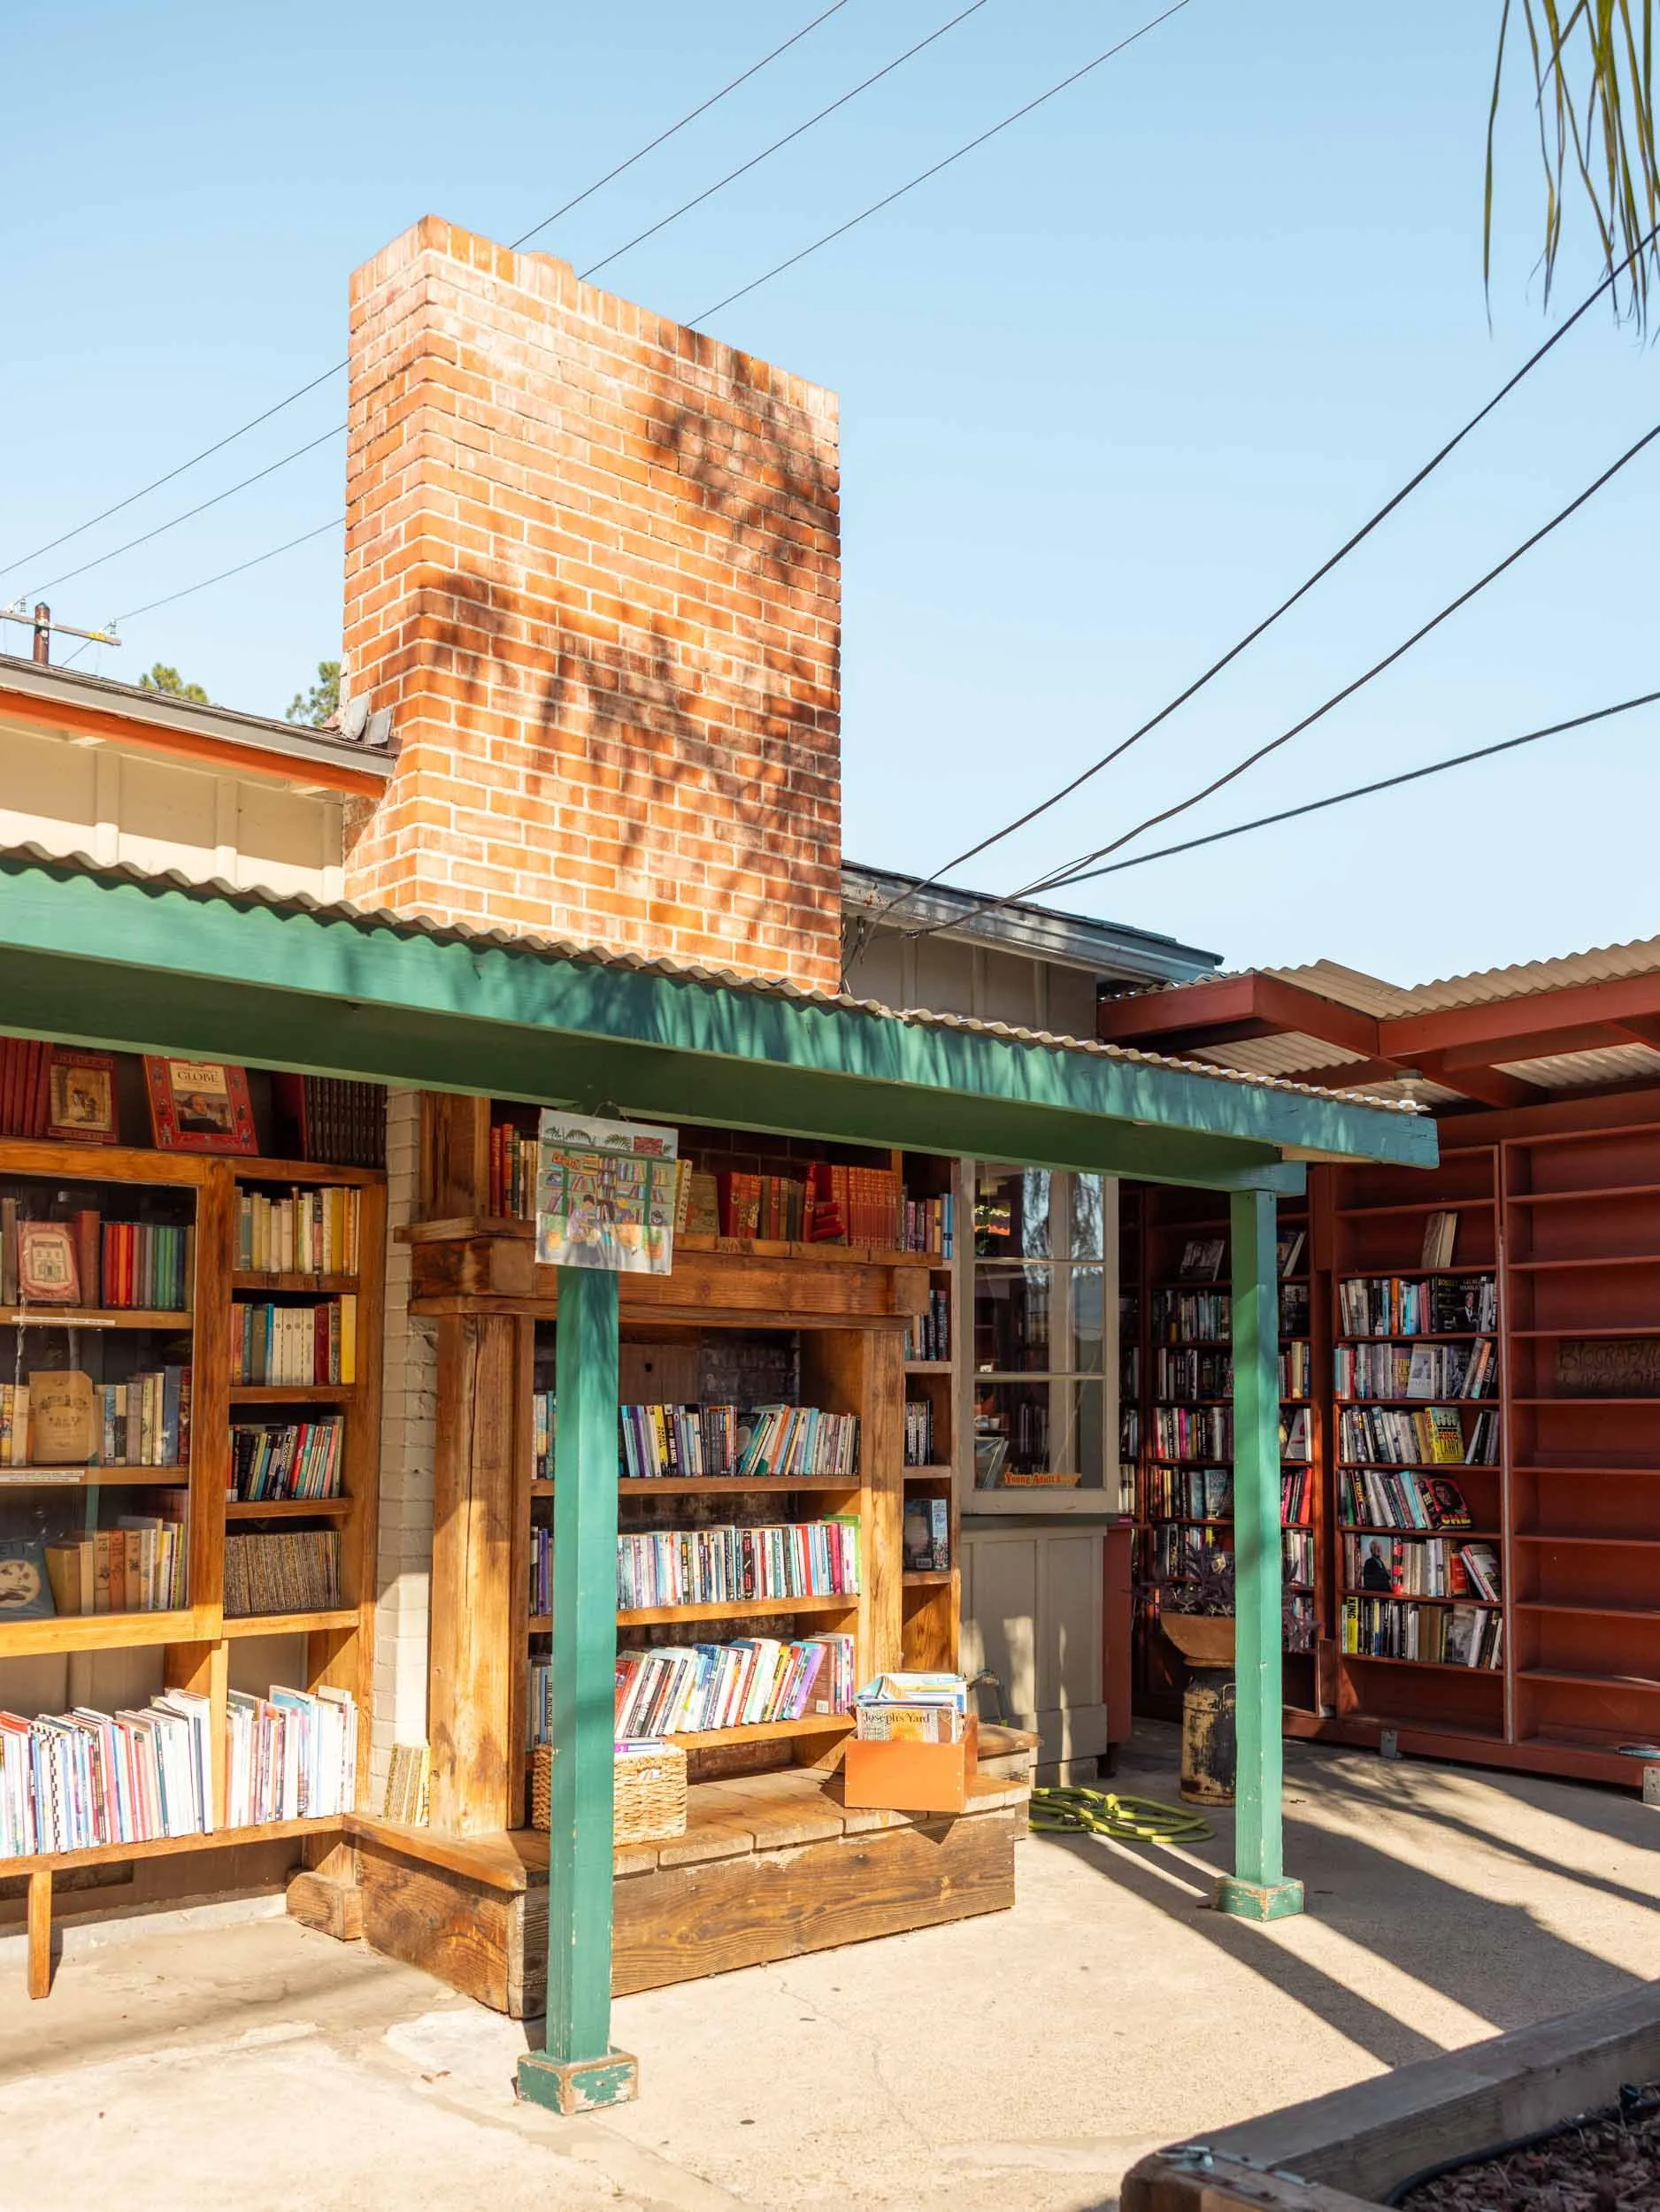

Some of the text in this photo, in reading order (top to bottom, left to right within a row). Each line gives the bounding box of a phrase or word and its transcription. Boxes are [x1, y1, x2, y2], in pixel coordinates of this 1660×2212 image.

[177, 1070, 220, 1084] GLOBE
[1438, 1432, 1459, 1441] KING
[1440, 1440, 1459, 1455] LARRY
[1004, 1472, 1031, 1486] Young
[1034, 1472, 1055, 1485] Adult
[1441, 1514, 1472, 1525] CHE
[1347, 1599, 1356, 1619] KING
[906, 1711, 931, 1724] Yard
